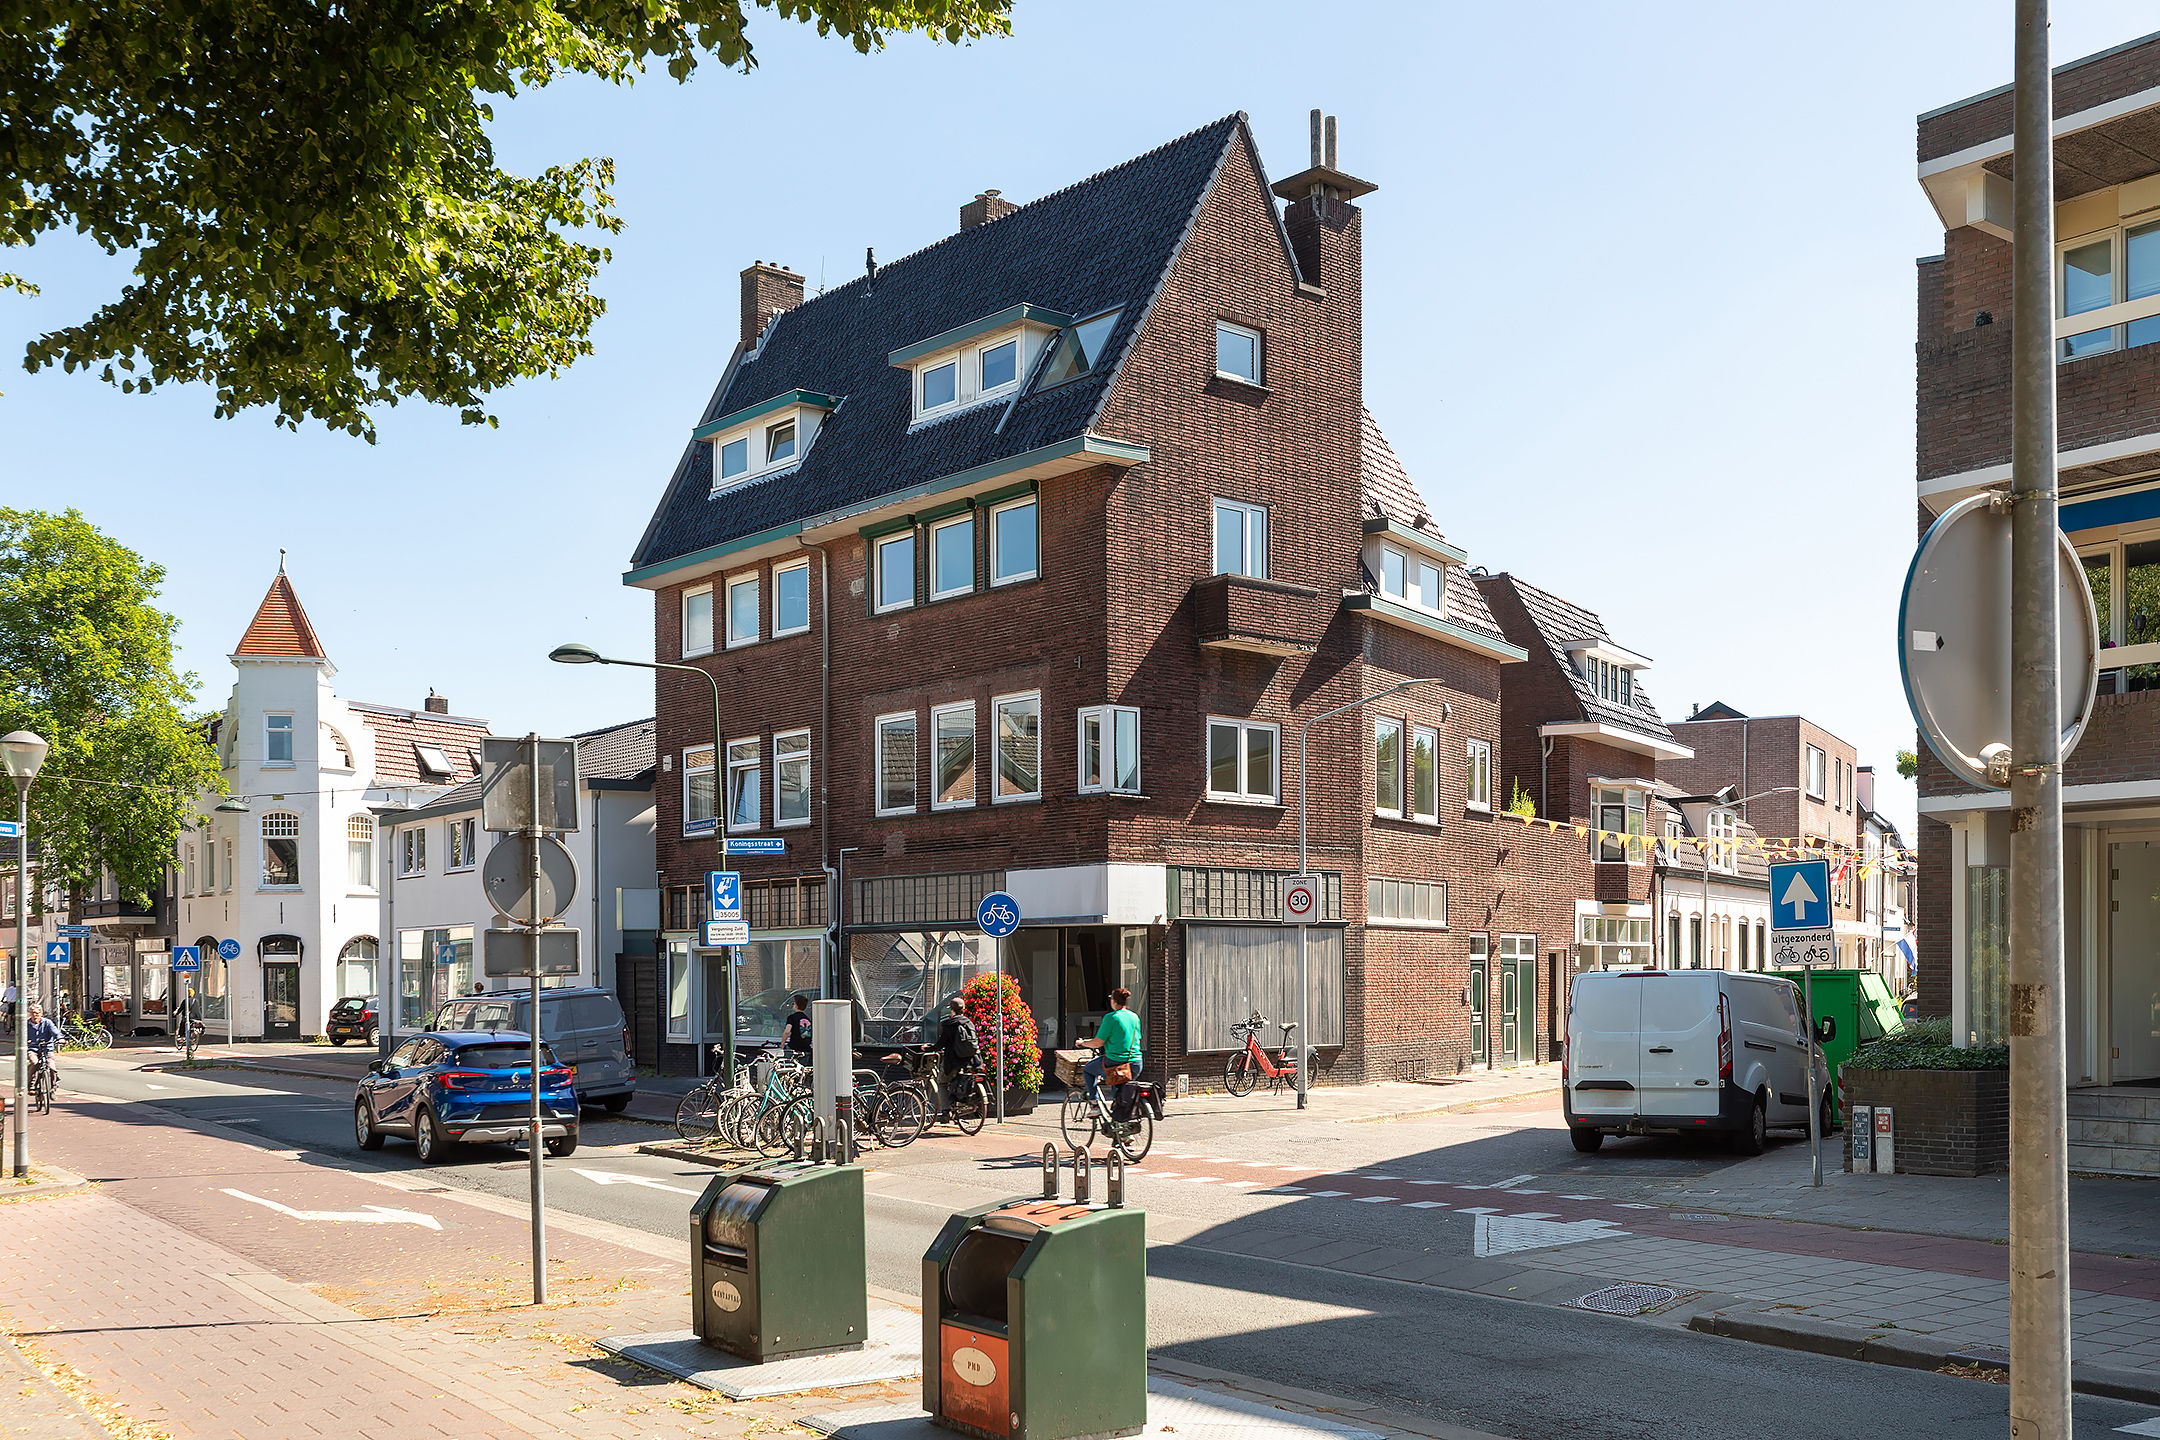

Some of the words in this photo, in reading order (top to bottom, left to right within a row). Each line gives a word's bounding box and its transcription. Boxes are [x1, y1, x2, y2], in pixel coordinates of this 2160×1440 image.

[1292, 895, 1308, 905] 30
[1772, 932, 1831, 945] uitgezonderd
[967, 1361, 981, 1372] PMD
